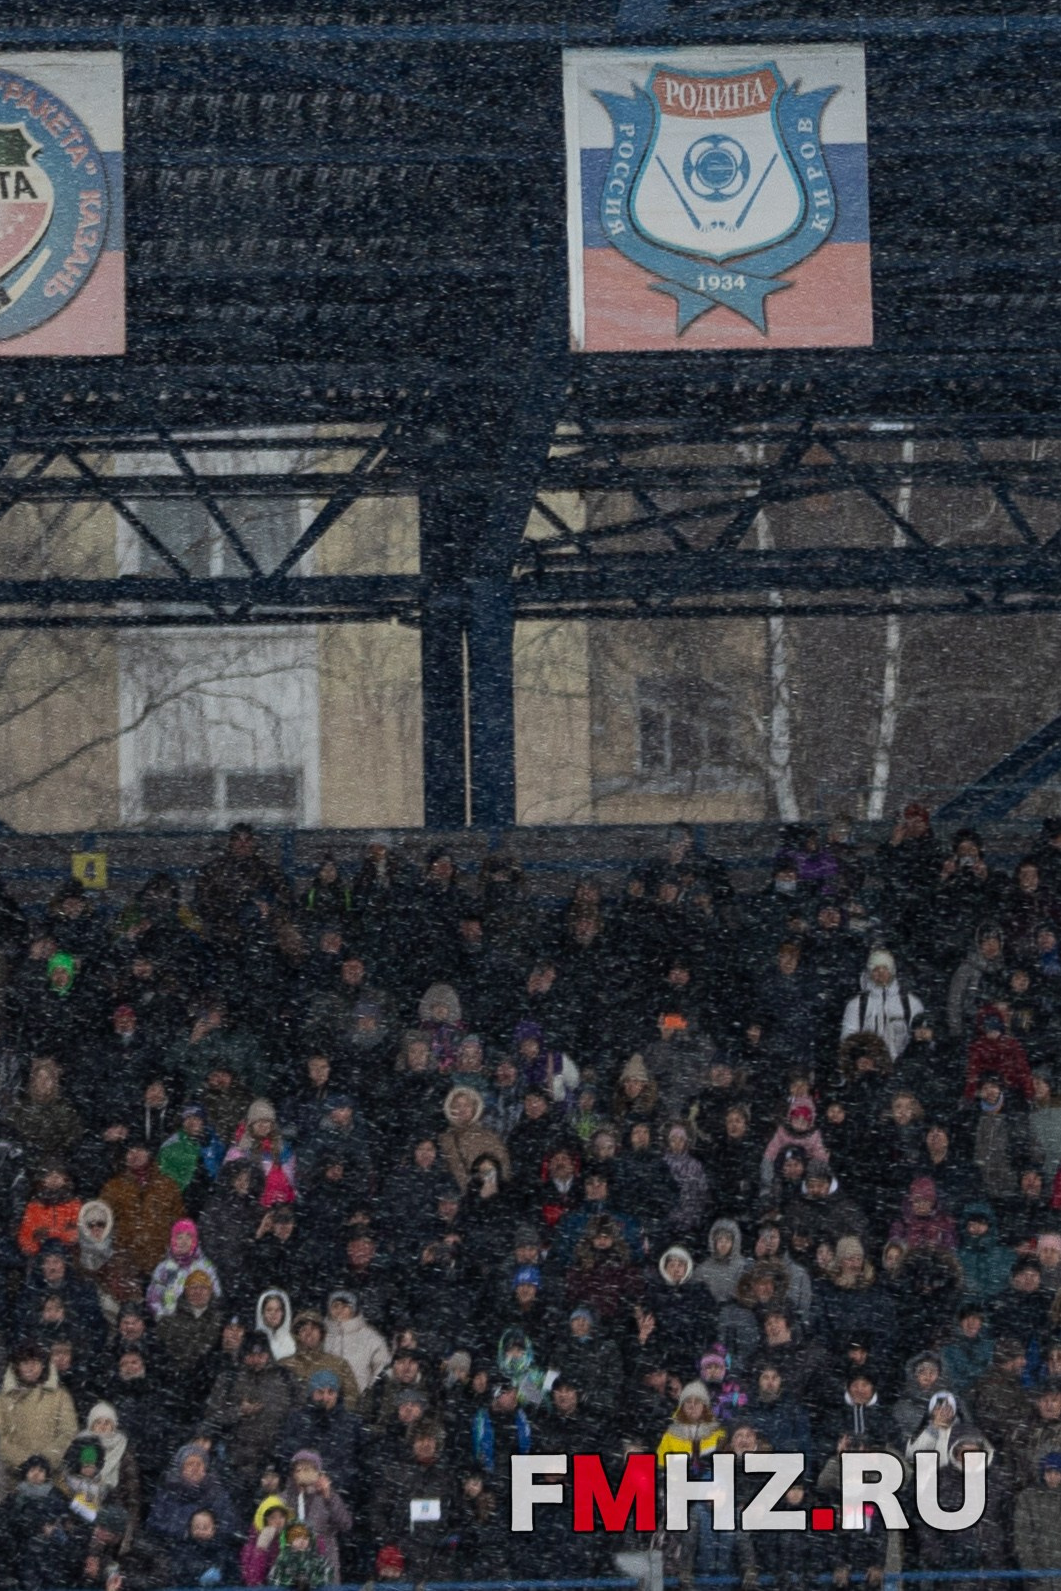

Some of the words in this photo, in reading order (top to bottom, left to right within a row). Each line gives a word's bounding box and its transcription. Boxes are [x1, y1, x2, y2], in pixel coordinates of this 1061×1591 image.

[663, 76, 769, 118] РОДИНА
[605, 121, 637, 237] РОССИЯ
[796, 116, 831, 233] КИРОВ
[43, 188, 102, 299] КАЗАНЬ
[696, 274, 747, 291] 1934
